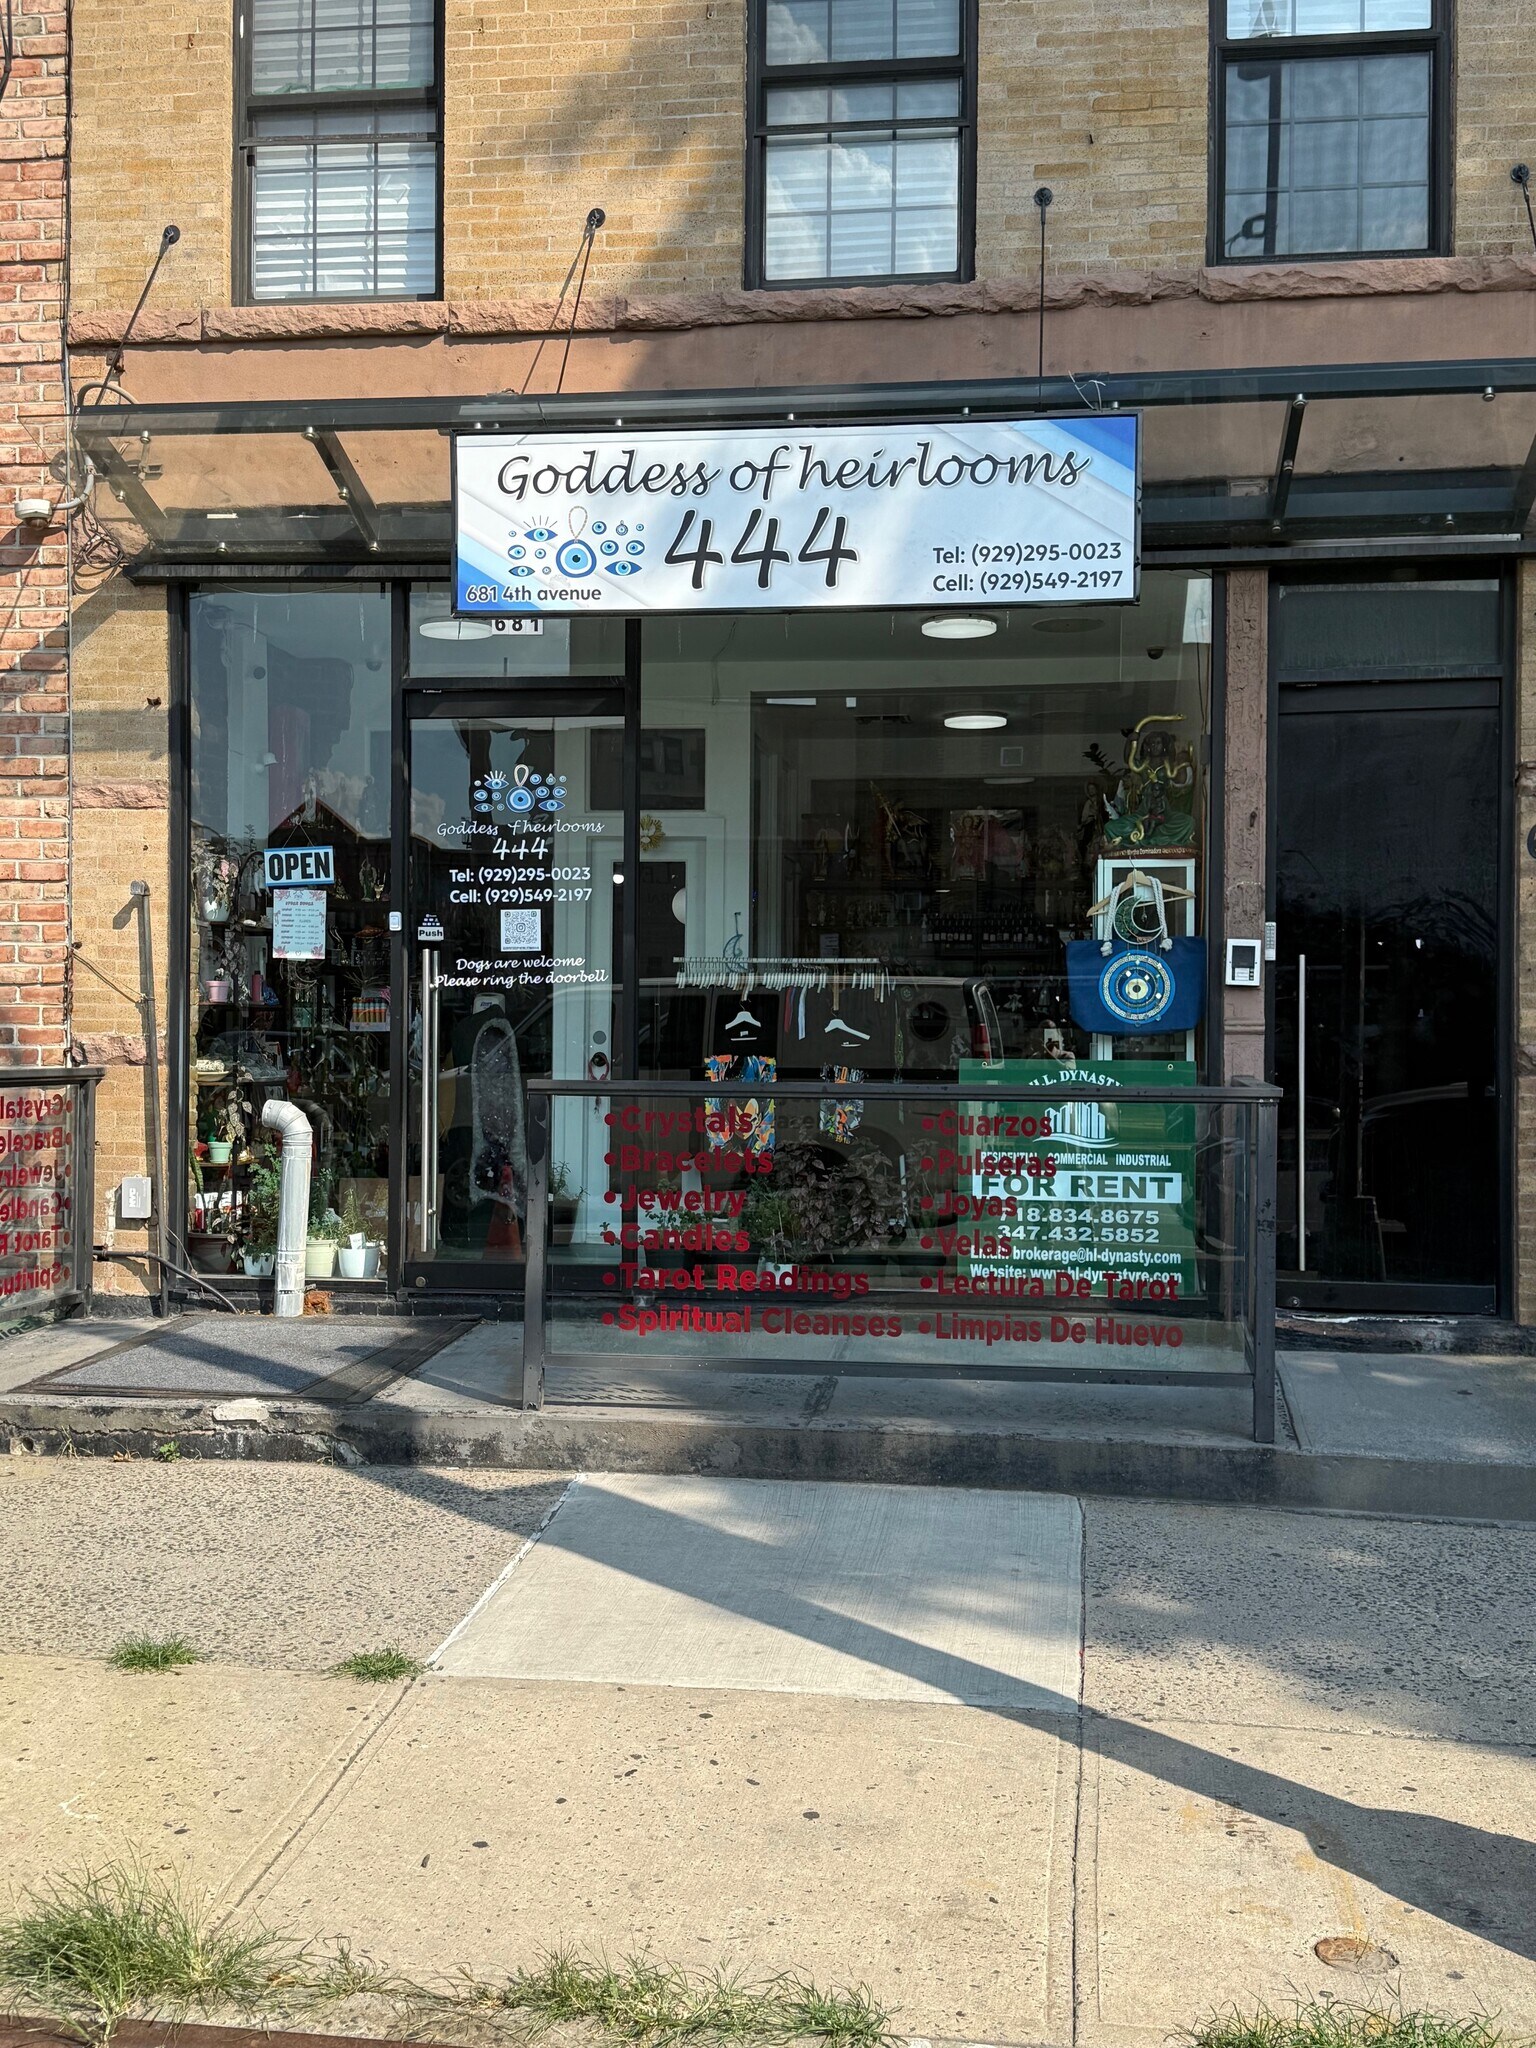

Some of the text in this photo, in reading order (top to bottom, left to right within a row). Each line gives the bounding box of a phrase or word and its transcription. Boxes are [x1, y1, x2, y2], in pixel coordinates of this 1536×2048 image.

[498, 441, 1090, 501] Goddess of heirlooms
[664, 506, 858, 590] 444
[932, 542, 1122, 567] Tel: (929)295-0023
[466, 585, 602, 602] 681 4th avenue
[932, 570, 1123, 594] Cell: (929)549-2197
[495, 618, 538, 632] 681
[437, 821, 499, 836] Goddess
[523, 819, 605, 834] heirlooms
[493, 837, 548, 861] 444
[268, 851, 331, 881] OPEN
[449, 866, 591, 884] Tel: (929)295-0023
[450, 887, 592, 905] Cell: (929)549-2197
[456, 955, 585, 973] Dogs are welcome
[436, 970, 608, 988] Please ring the doorbell
[620, 1105, 754, 1137] Crystals
[937, 1110, 1052, 1137] Cuarzos
[620, 1145, 773, 1174] Bracelets
[938, 1149, 1057, 1178] Pulseras
[1115, 1154, 1172, 1167] INDUSTRIAL
[981, 1173, 1174, 1199] FOR RENT
[619, 1184, 746, 1217] Jewelry
[937, 1191, 1017, 1221] Joyas
[1000, 1206, 1160, 1225] 718.834.8675
[620, 1223, 751, 1252] Candles
[937, 1229, 1012, 1258] Velas
[997, 1224, 1160, 1243] 347.432.5852
[1013, 1246, 1182, 1267] brokerage@hl-dynasty.com
[618, 1263, 870, 1299] Tarot Readings
[937, 1270, 1180, 1301] Lectura De Tarot
[970, 1264, 1182, 1285] Website: wwhl-dynstyre.com
[618, 1304, 903, 1338] Spiritual Cleanses
[935, 1312, 1183, 1347] Limpias De Huevo
